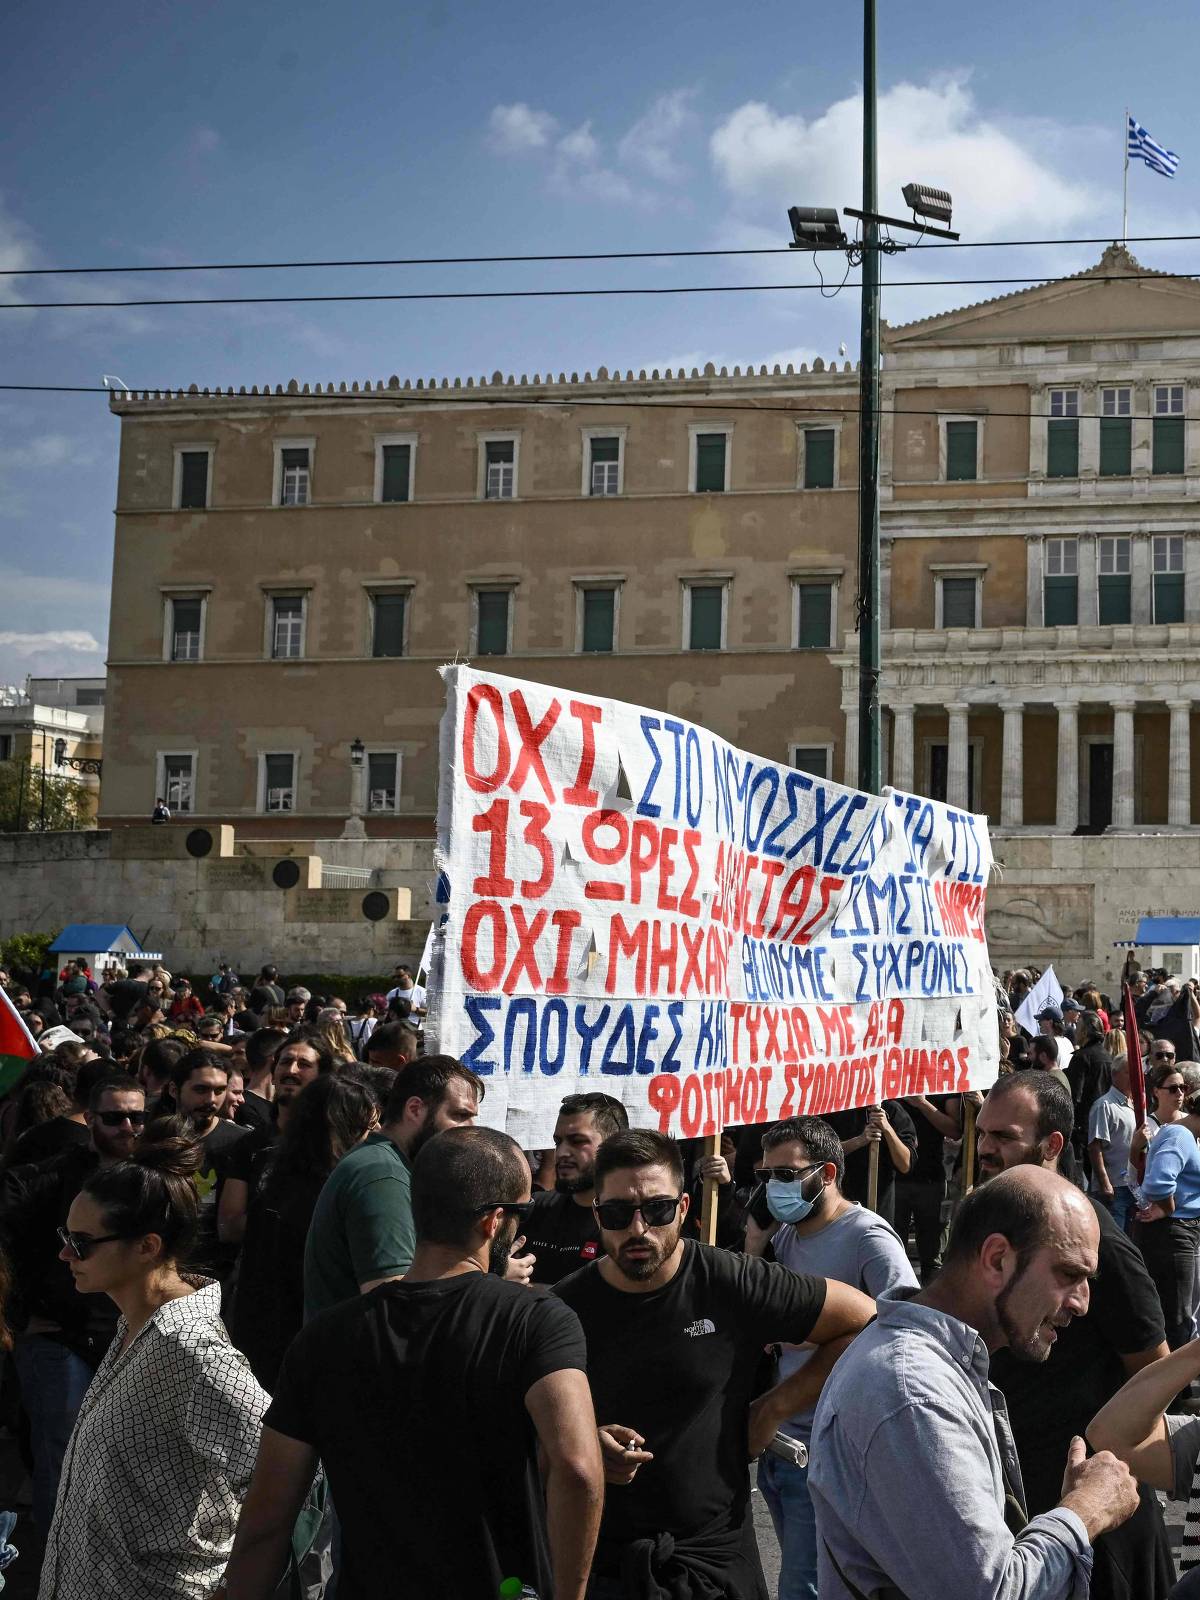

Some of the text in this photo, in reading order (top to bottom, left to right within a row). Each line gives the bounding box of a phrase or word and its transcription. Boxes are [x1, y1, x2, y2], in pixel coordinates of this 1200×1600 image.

[462, 684, 602, 808] ΟΧΙ
[637, 715, 703, 828] ΣΤΟ
[946, 810, 984, 883] ΤΙΣ
[472, 798, 554, 898] 13
[582, 809, 701, 920] ΩΡΕΣ
[461, 900, 582, 995] ΟΧΙ
[460, 995, 683, 1076] ΣΠΟΥΔΕΣ
[693, 1000, 728, 1070] ΚΑΙ
[816, 1005, 857, 1057] ΜΕ
